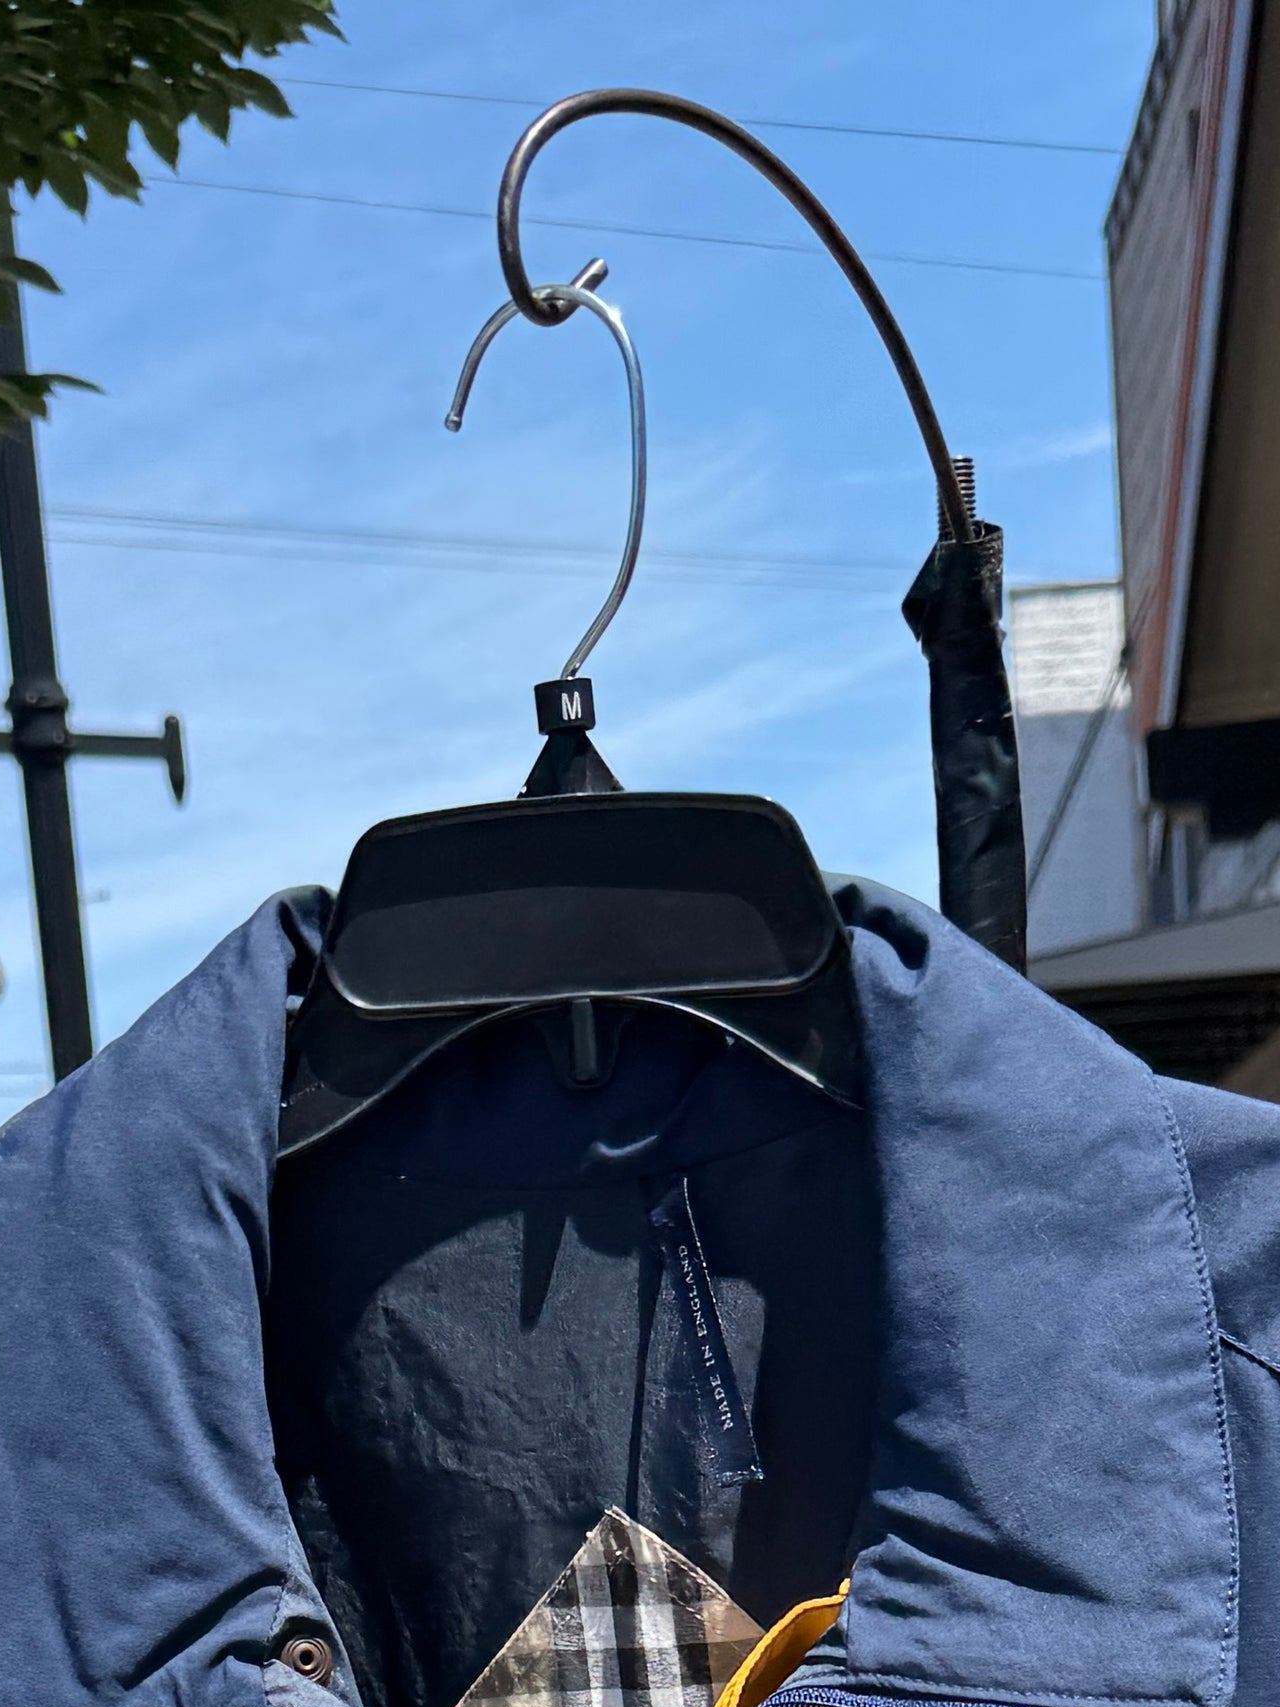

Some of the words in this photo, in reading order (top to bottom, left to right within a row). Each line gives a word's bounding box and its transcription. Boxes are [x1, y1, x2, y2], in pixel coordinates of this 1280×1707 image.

[561, 691, 582, 721] M
[678, 1245, 708, 1337] ENGLAND
[701, 1345, 716, 1367] IN
[709, 1373, 734, 1431] MADE
